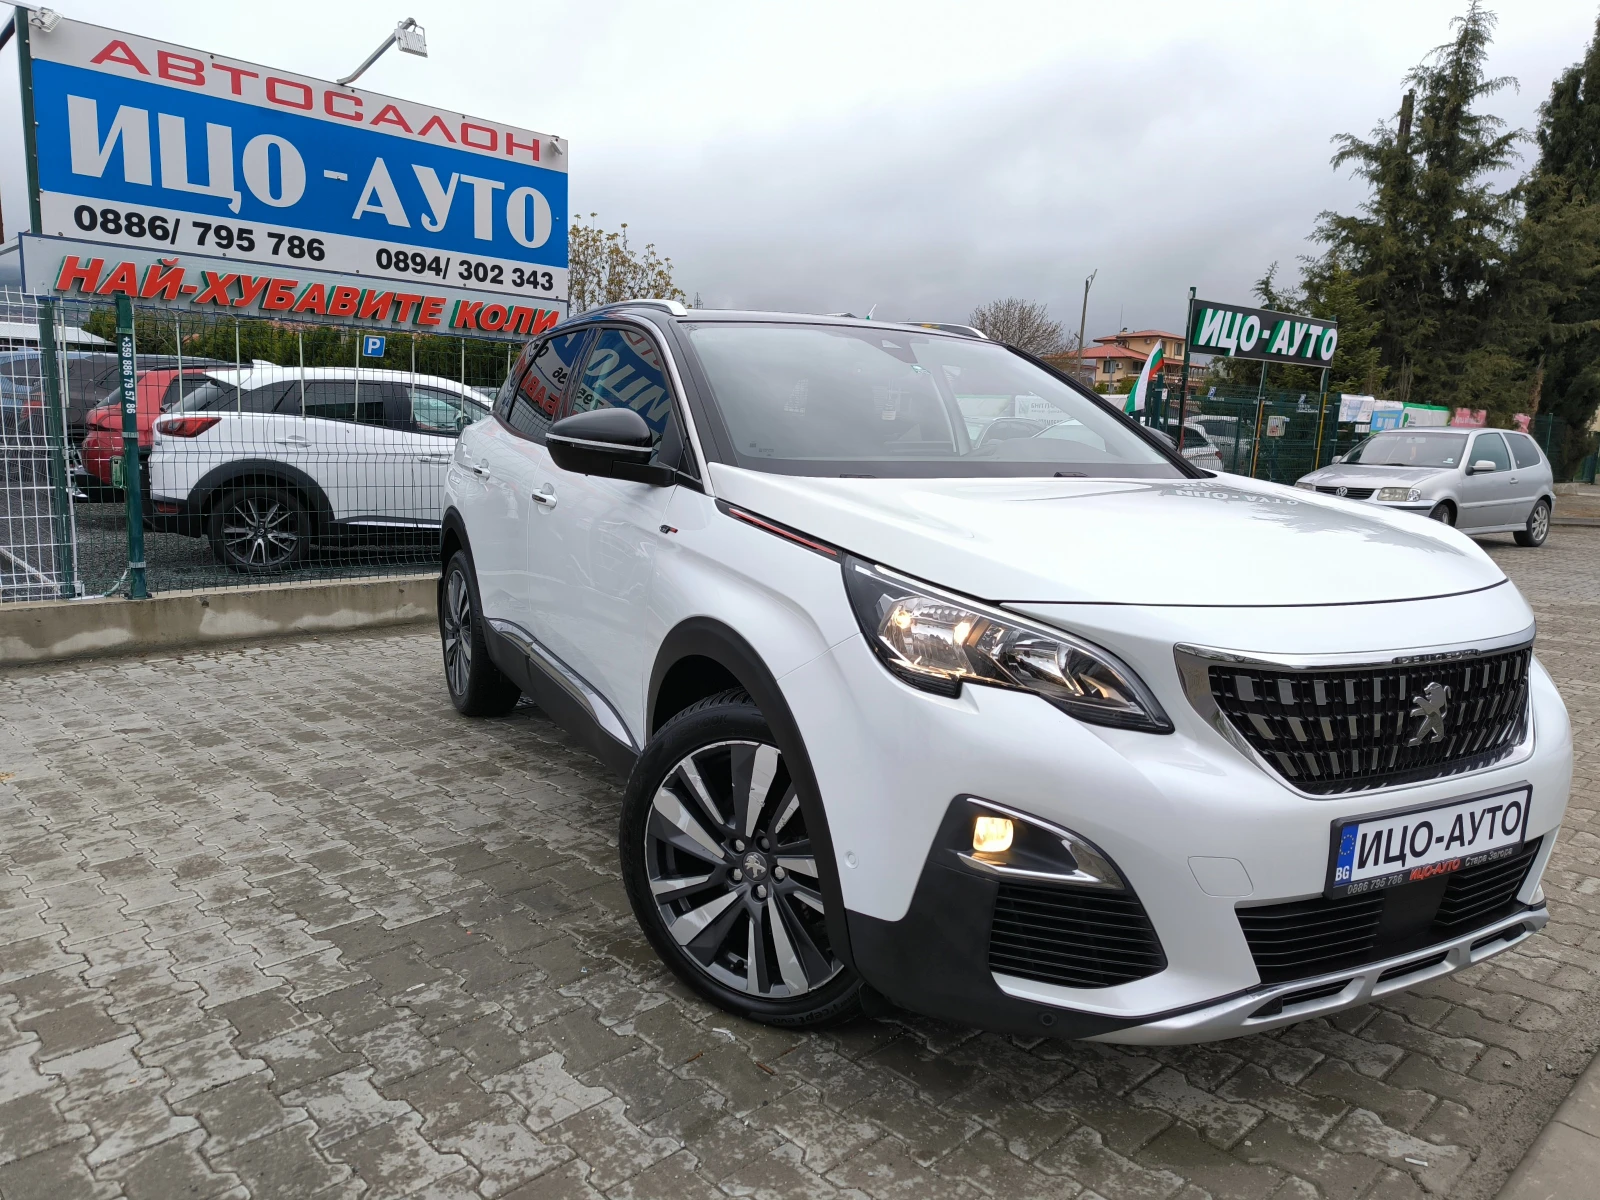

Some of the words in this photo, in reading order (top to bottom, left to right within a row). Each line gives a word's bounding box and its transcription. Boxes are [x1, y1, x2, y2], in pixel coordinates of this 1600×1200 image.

[90, 39, 540, 162] АВТОСАЛОН
[73, 204, 181, 245] 0886/
[191, 220, 256, 253] 795
[266, 231, 326, 262] 786
[375, 247, 451, 280] 0894/
[457, 259, 504, 285] 302
[511, 267, 554, 292] 343
[54, 254, 447, 326] НАЙ-ХУБАВИТЕ
[450, 299, 560, 336] КОЛИ
[1196, 307, 1338, 361] ИЦО-АУТО
[121, 336, 132, 358] +359
[367, 338, 381, 354] P
[122, 359, 133, 376] 886
[123, 377, 134, 389] 79
[124, 390, 135, 402] 57
[125, 403, 136, 414] 86
[1357, 800, 1522, 870] ИЦО-АУТО
[1335, 865, 1350, 882] BG
[1370, 876, 1387, 890] 795
